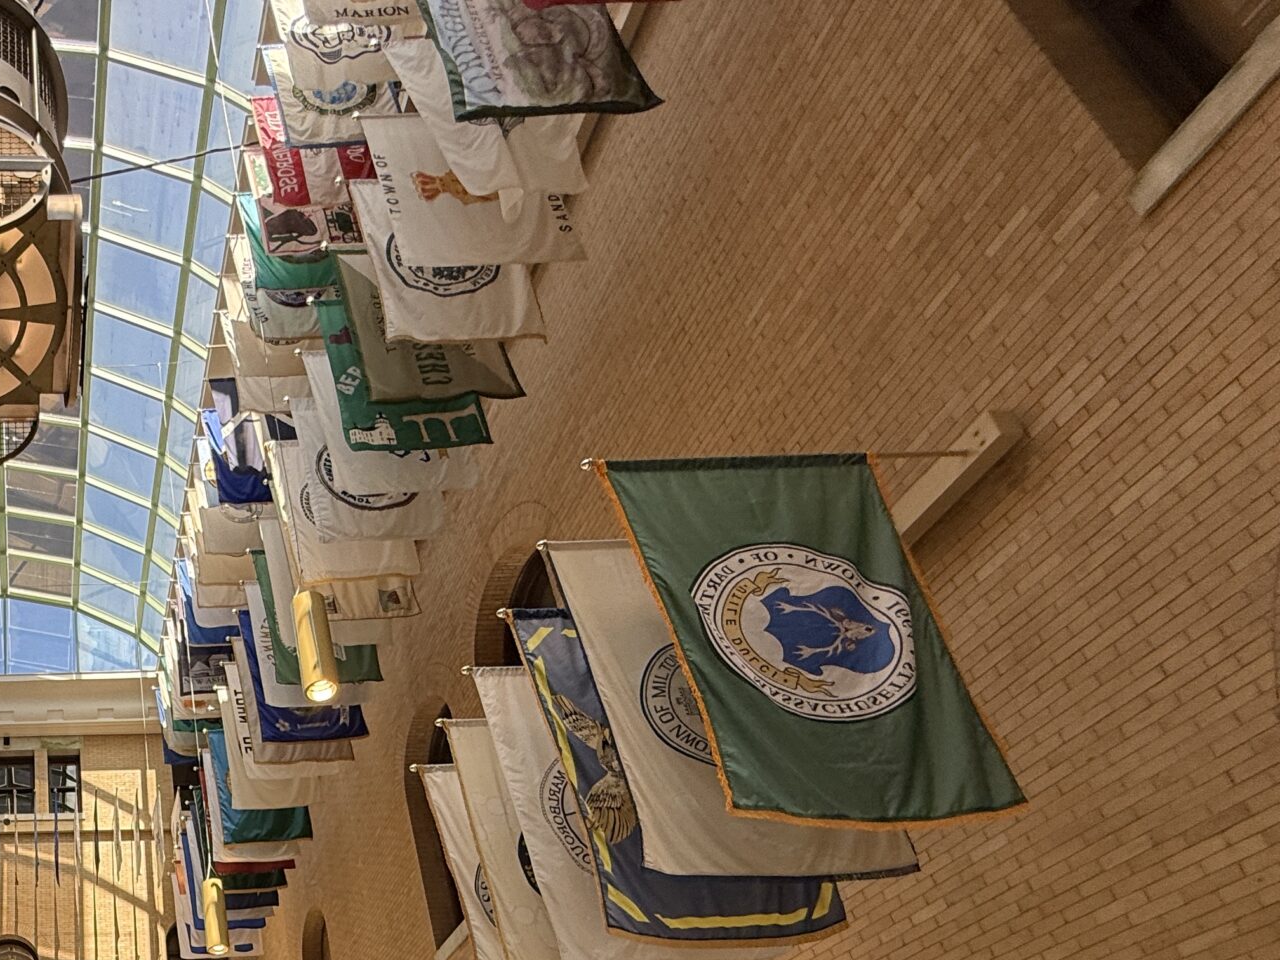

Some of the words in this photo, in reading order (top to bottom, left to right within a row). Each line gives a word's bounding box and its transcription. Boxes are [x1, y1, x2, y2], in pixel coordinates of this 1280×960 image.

[335, 5, 410, 19] MARION
[373, 153, 388, 169] OF
[381, 173, 402, 216] TOWN
[247, 290, 258, 302] OF
[252, 307, 269, 324] CITY
[340, 490, 371, 504] TOWN
[653, 704, 675, 724] OF
[669, 724, 710, 755] OWN
